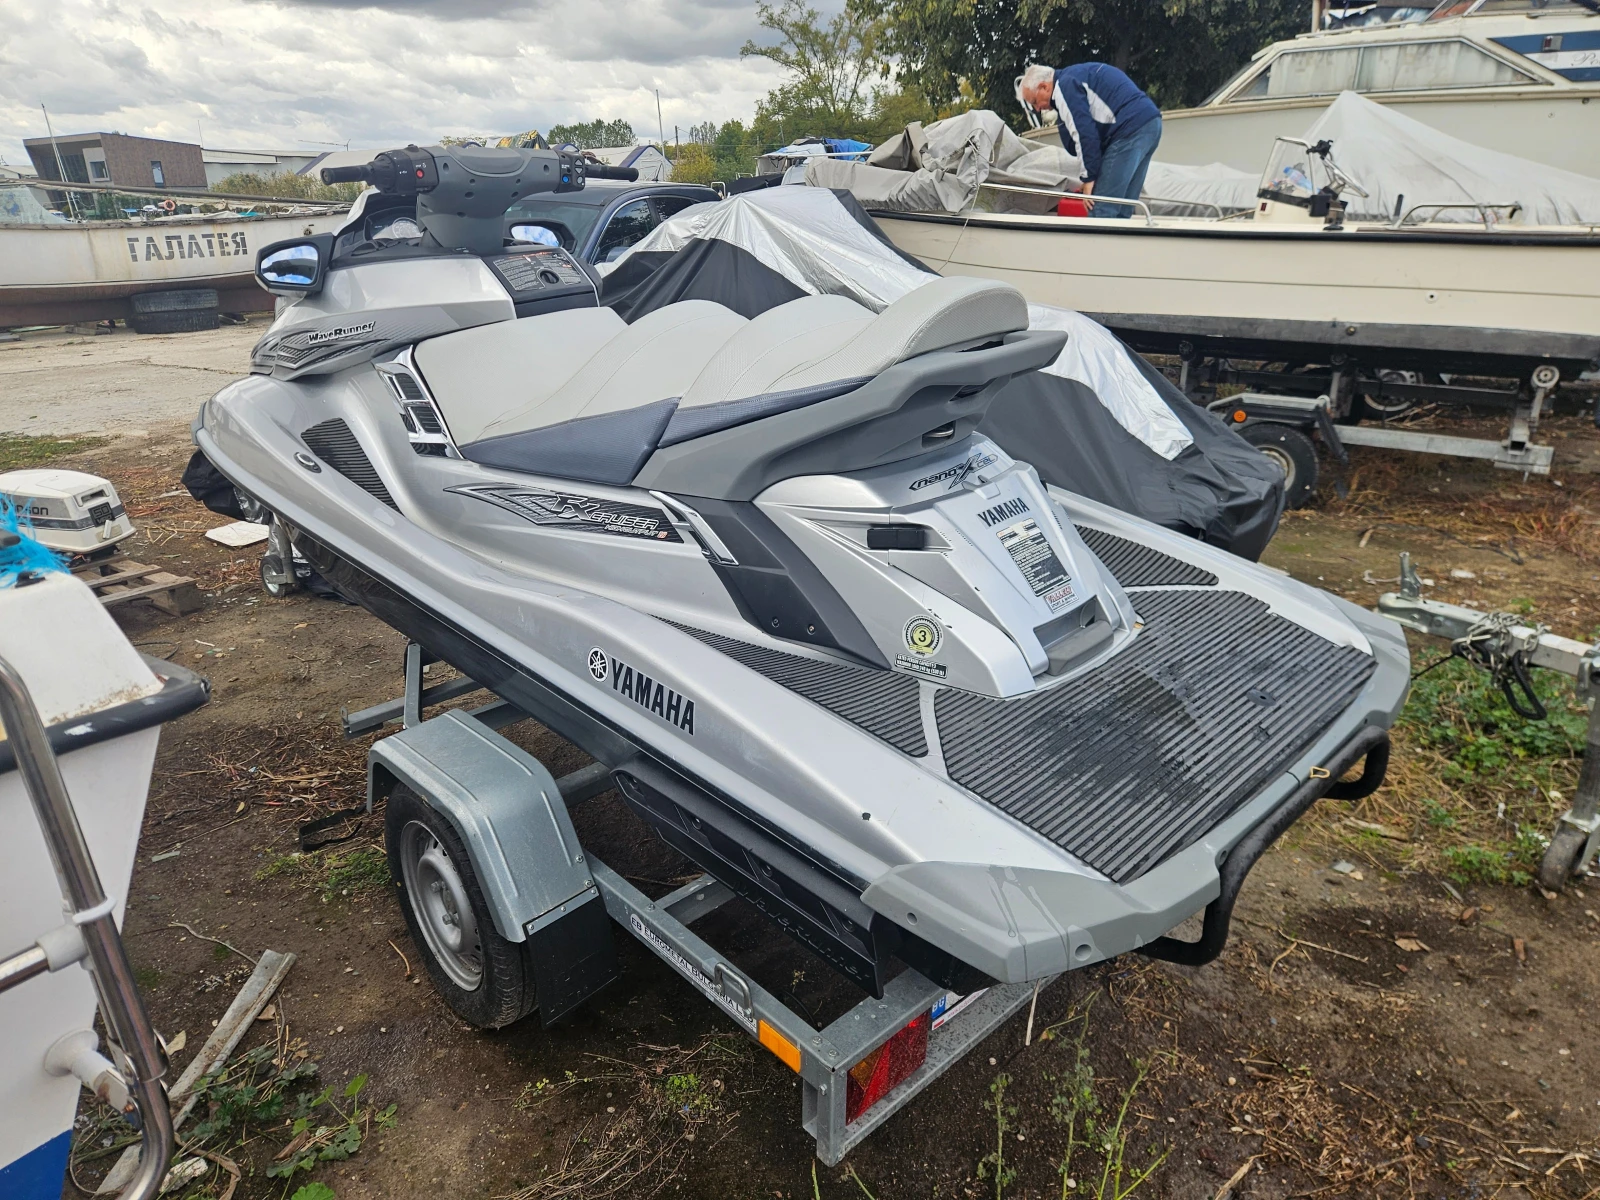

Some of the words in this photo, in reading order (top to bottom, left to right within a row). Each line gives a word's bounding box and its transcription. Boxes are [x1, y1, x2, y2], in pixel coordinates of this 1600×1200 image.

[127, 231, 248, 262] ГАЛАТЕЯ
[308, 321, 376, 344] WaveRunner
[93, 504, 110, 518] 50
[551, 494, 600, 521] FX
[589, 511, 660, 530] CRUISER
[977, 497, 1031, 528] YAMAHA
[918, 629, 927, 643] 3
[611, 657, 695, 735] YAMAHA
[632, 916, 642, 931] EB
[932, 995, 945, 1013] BG
